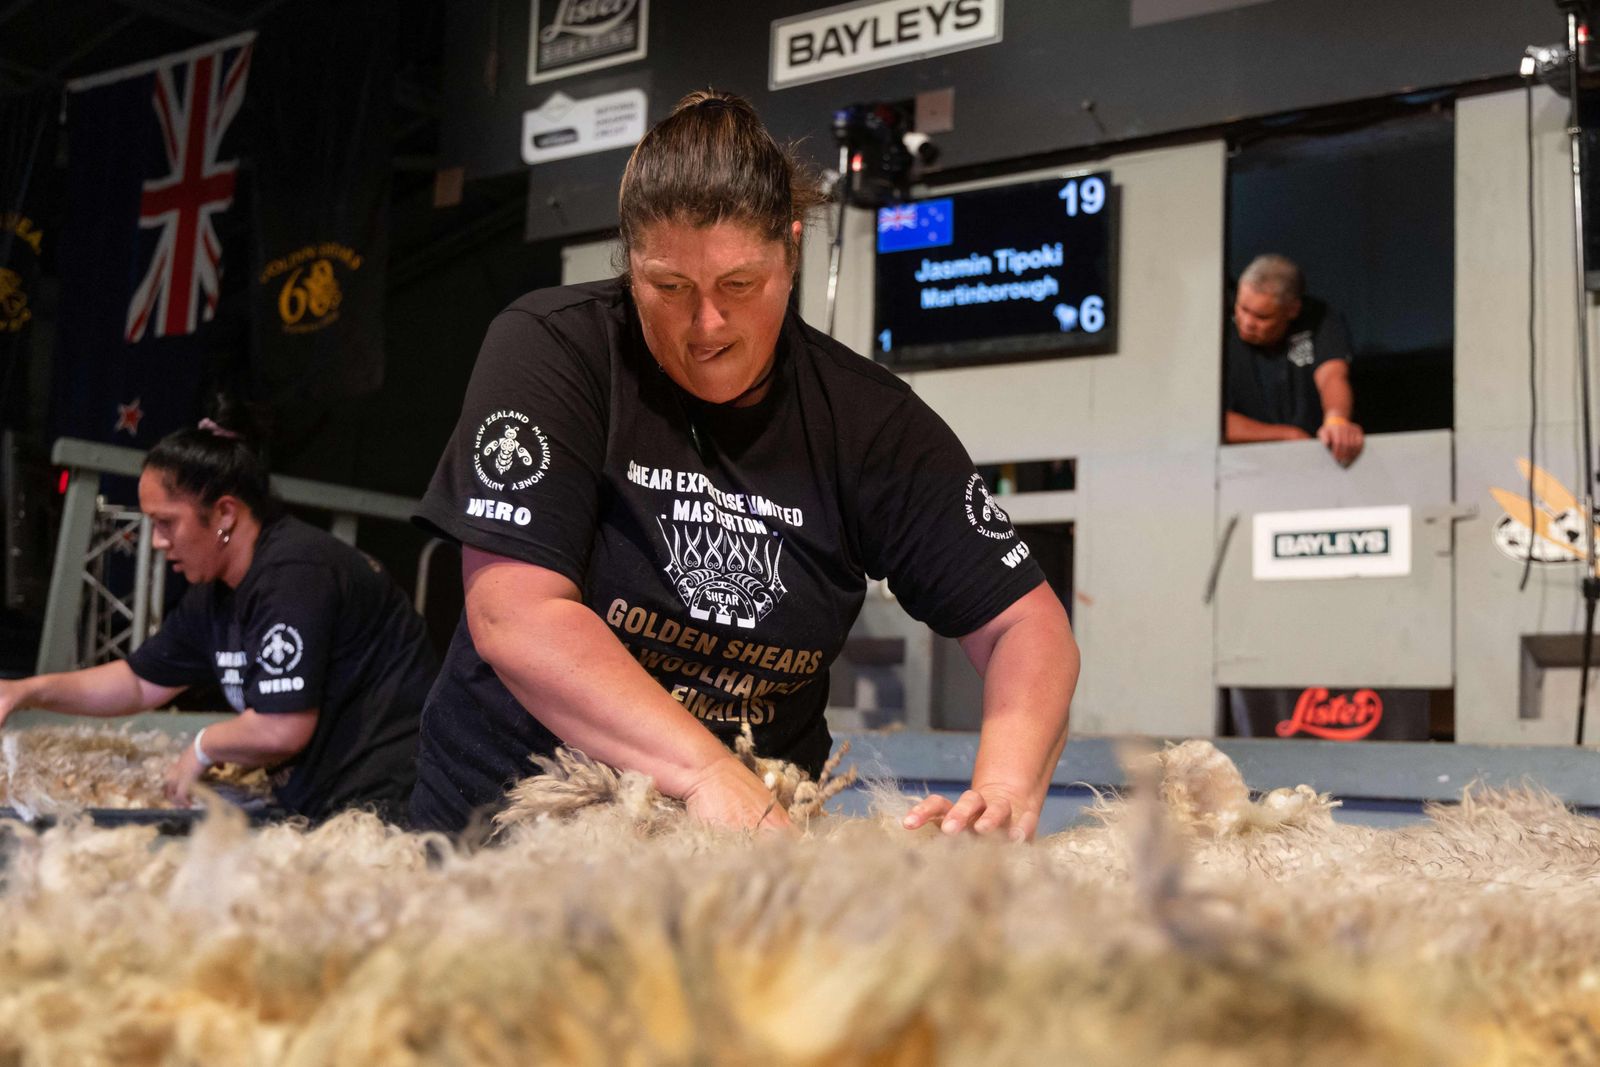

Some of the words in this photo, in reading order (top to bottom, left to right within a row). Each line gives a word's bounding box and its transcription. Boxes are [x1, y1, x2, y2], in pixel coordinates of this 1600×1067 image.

[788, 0, 982, 68] BAYLEYS
[1058, 177, 1105, 217] 19
[915, 253, 992, 282] Jasmin
[994, 242, 1063, 275] Tipoki
[921, 275, 1058, 309] Martinborough
[1079, 295, 1106, 334] 6
[878, 328, 893, 353] 1
[485, 410, 530, 426] ZEALAND
[475, 424, 486, 449] NEW
[474, 453, 505, 492] AUTHENTIC
[511, 470, 545, 491] HONEY
[627, 460, 673, 490] SHEAR
[676, 471, 747, 513] EXPTISE
[965, 472, 983, 501] ZEALAN
[466, 498, 532, 526] WERO
[672, 499, 768, 534] MASTERTON
[965, 504, 978, 526] NEW
[977, 525, 1015, 540] UTHENTIC
[1275, 530, 1388, 558] BAYLEYS
[1001, 540, 1030, 569] WE
[705, 590, 739, 606] SHEAR
[606, 597, 719, 656] GOLDEN
[722, 640, 823, 675] SHEARS
[671, 683, 777, 725] FINALIST
[1275, 686, 1383, 740] Lister
